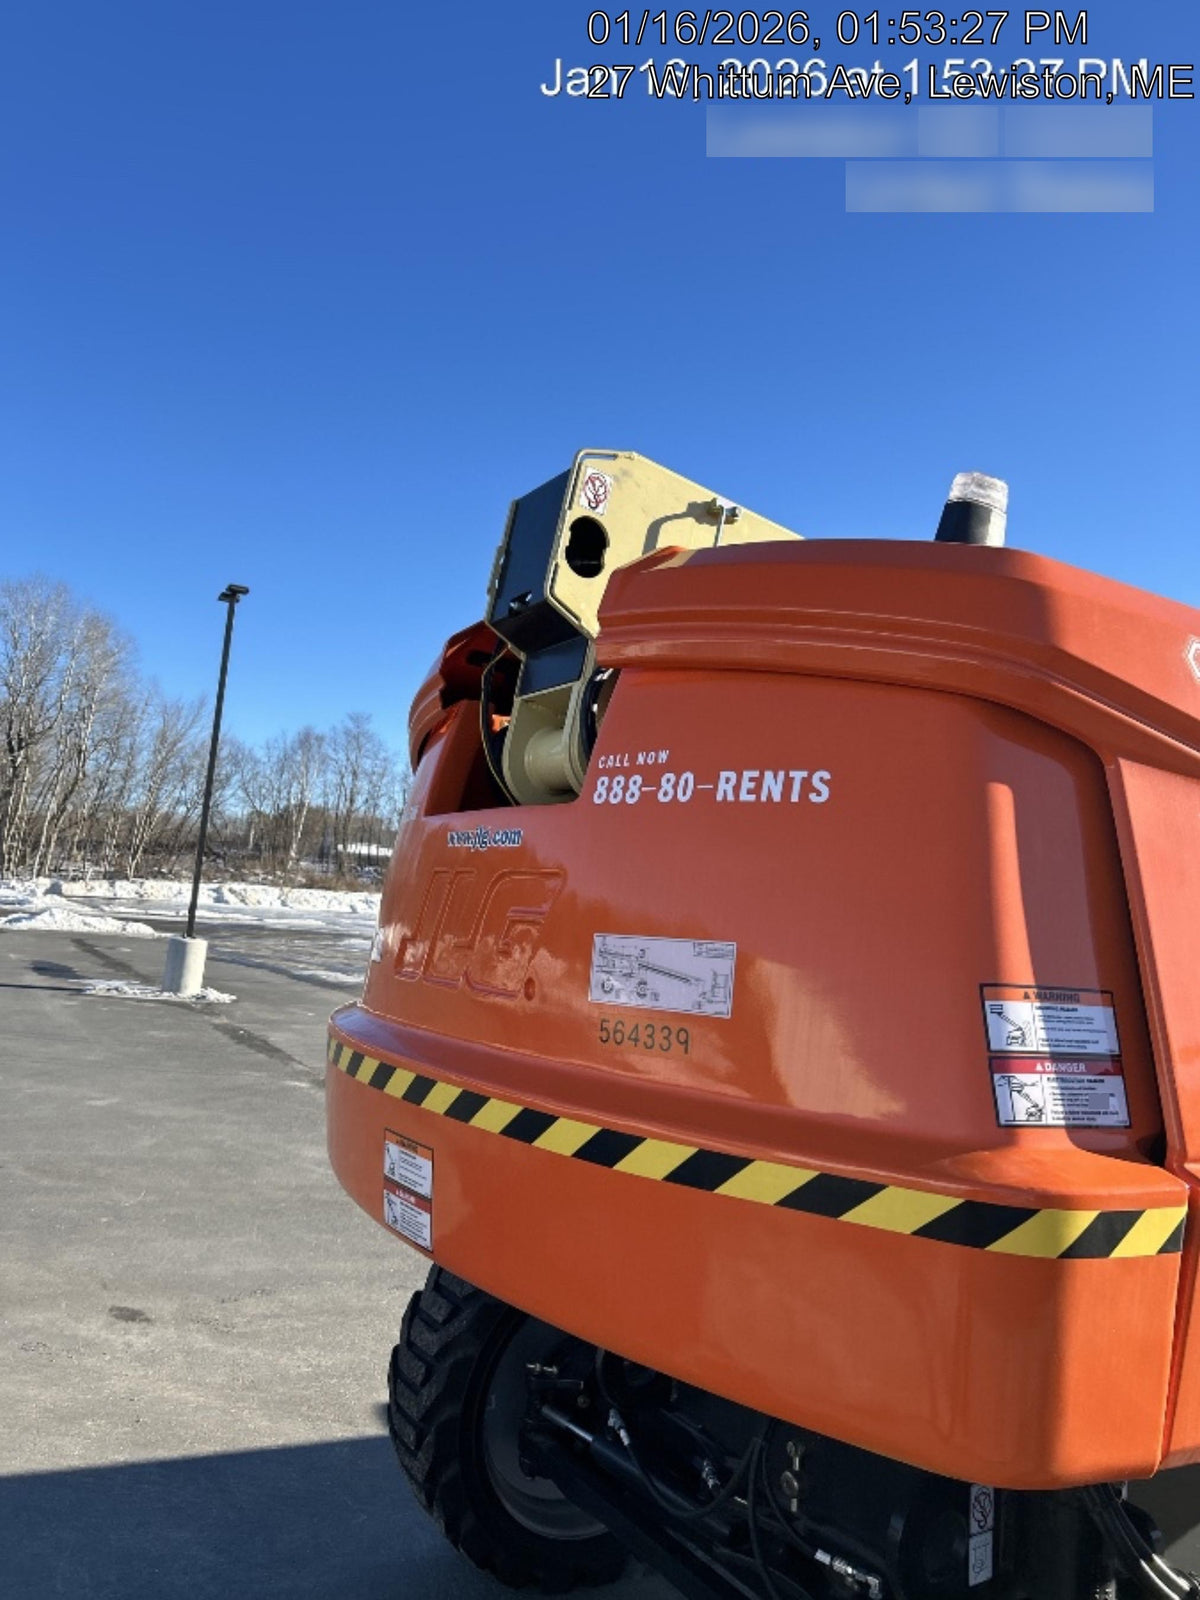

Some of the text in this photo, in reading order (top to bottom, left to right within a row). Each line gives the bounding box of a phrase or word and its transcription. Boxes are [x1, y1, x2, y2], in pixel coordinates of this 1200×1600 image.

[598, 750, 670, 769] CALL NOW
[593, 769, 832, 805] 888-80-RENTS
[447, 825, 524, 851] www.jlg.com
[599, 1018, 692, 1055] 564339
[1044, 1062, 1087, 1073] DANGER
